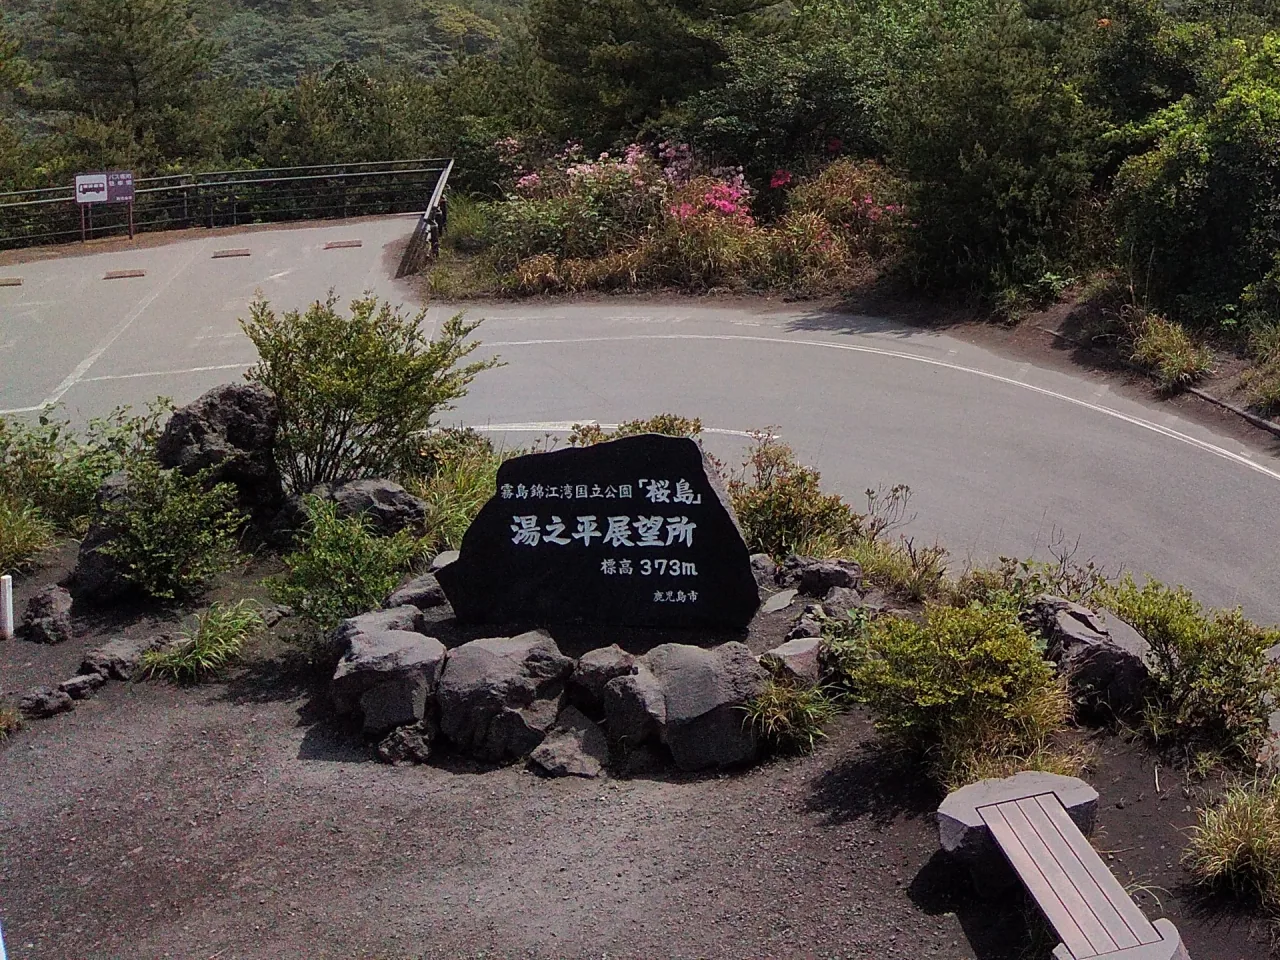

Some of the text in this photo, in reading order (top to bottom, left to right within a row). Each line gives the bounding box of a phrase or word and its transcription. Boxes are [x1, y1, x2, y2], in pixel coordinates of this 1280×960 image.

[500, 483, 632, 499] 霧島錦江湾国立公園
[510, 515, 697, 547] 湯之平展望所
[600, 558, 698, 576] 標高 373m
[653, 590, 699, 603] 鹿児島市
